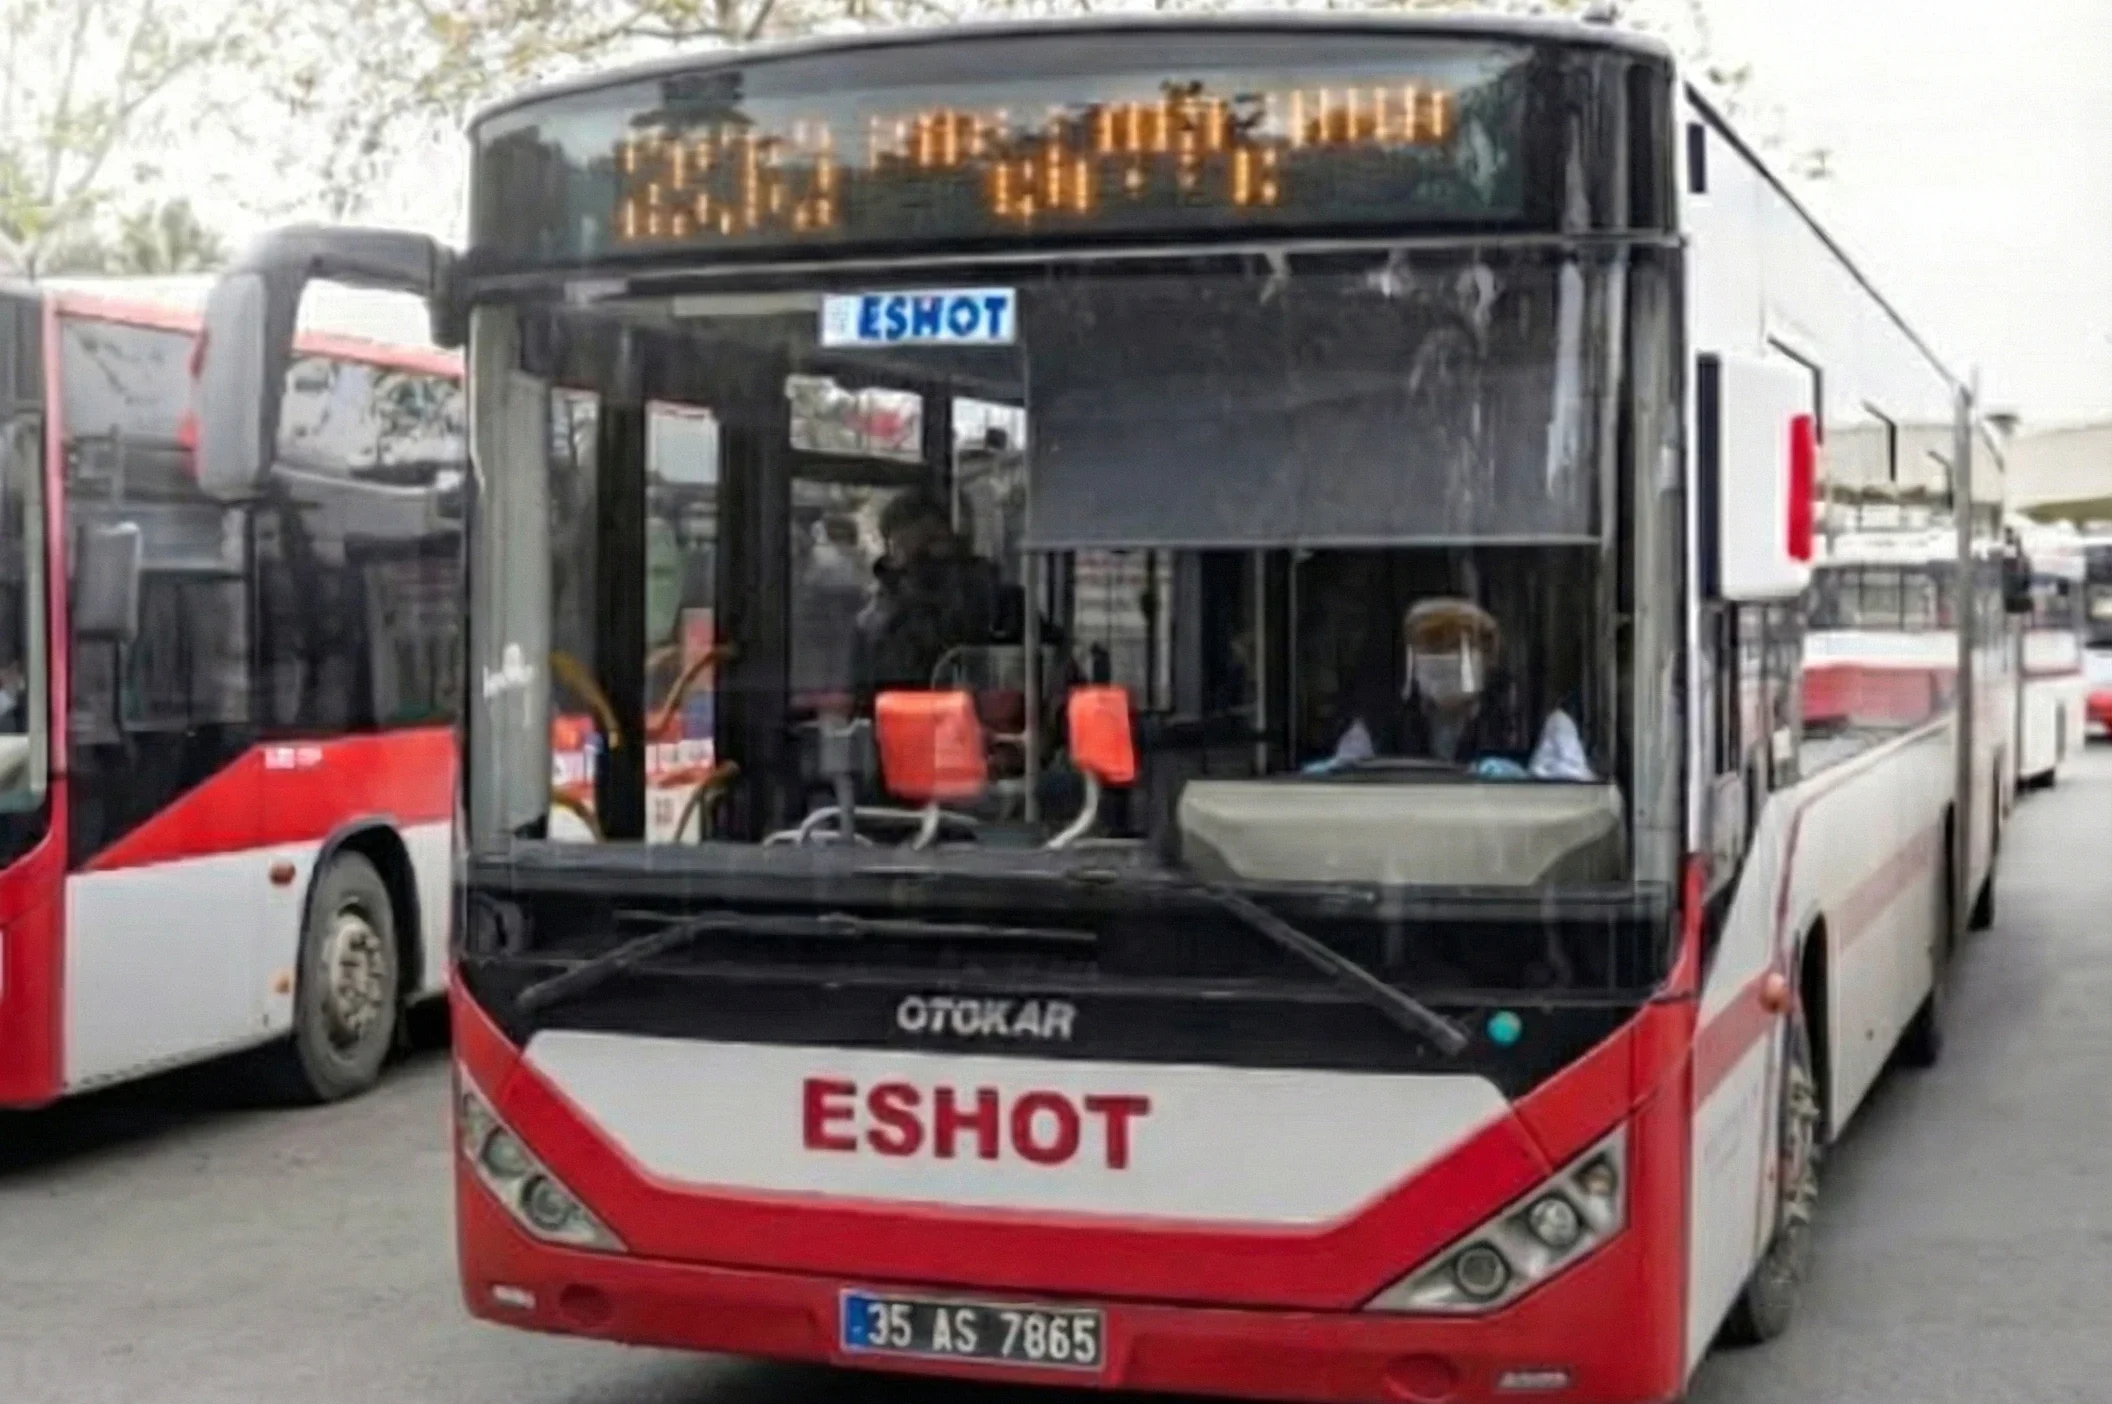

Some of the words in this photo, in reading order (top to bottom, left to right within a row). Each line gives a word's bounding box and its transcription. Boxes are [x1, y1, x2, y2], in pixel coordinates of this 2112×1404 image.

[859, 295, 1008, 340] ESHOT
[897, 997, 1078, 1040] OTOKAR
[803, 1078, 1151, 1169] ESHOT
[867, 1303, 912, 1347] 35
[932, 1308, 978, 1353] AS
[1000, 1312, 1096, 1362] 7865
